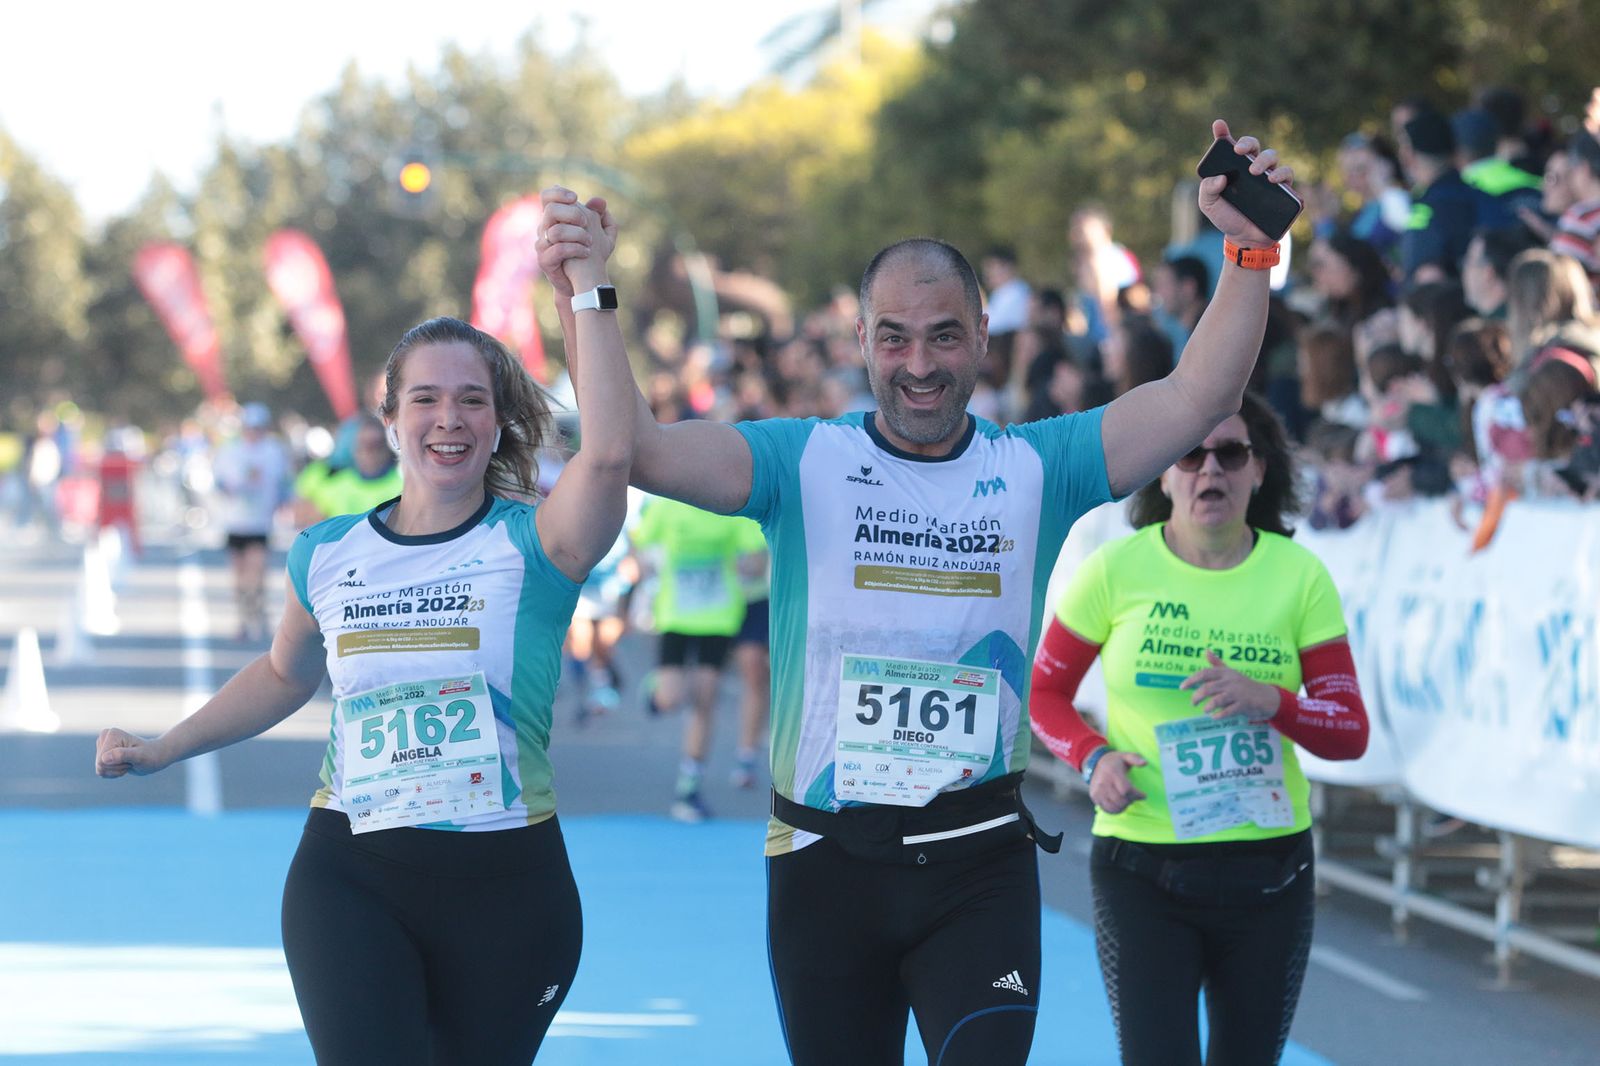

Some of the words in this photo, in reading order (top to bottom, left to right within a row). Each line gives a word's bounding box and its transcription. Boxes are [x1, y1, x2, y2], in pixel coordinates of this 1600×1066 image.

[846, 475, 884, 486] SPALL
[855, 506, 918, 524] Medio
[926, 516, 1001, 535] Maratón
[854, 523, 942, 550] Almería
[854, 550, 904, 564] RAMÓN
[909, 555, 939, 568] RUIZ
[942, 558, 1001, 573] ANDÚJAR
[399, 582, 471, 598] Maratón
[343, 599, 412, 622] Almería
[415, 617, 469, 627] ANDÚJAR
[1144, 623, 1201, 640] Medio
[1209, 628, 1282, 646] Maratón
[884, 669, 917, 680] Almería
[885, 662, 908, 671] Medio
[1136, 660, 1183, 673] RAMÓN
[379, 694, 404, 706] Almería
[855, 683, 977, 735] 5161
[360, 699, 481, 759] 5162
[892, 729, 935, 744] DIEGO
[391, 746, 442, 764] ÁNGELA
[1176, 731, 1274, 776] 5765
[1197, 766, 1264, 785] INMACULADA
[992, 981, 1029, 996] adidas
